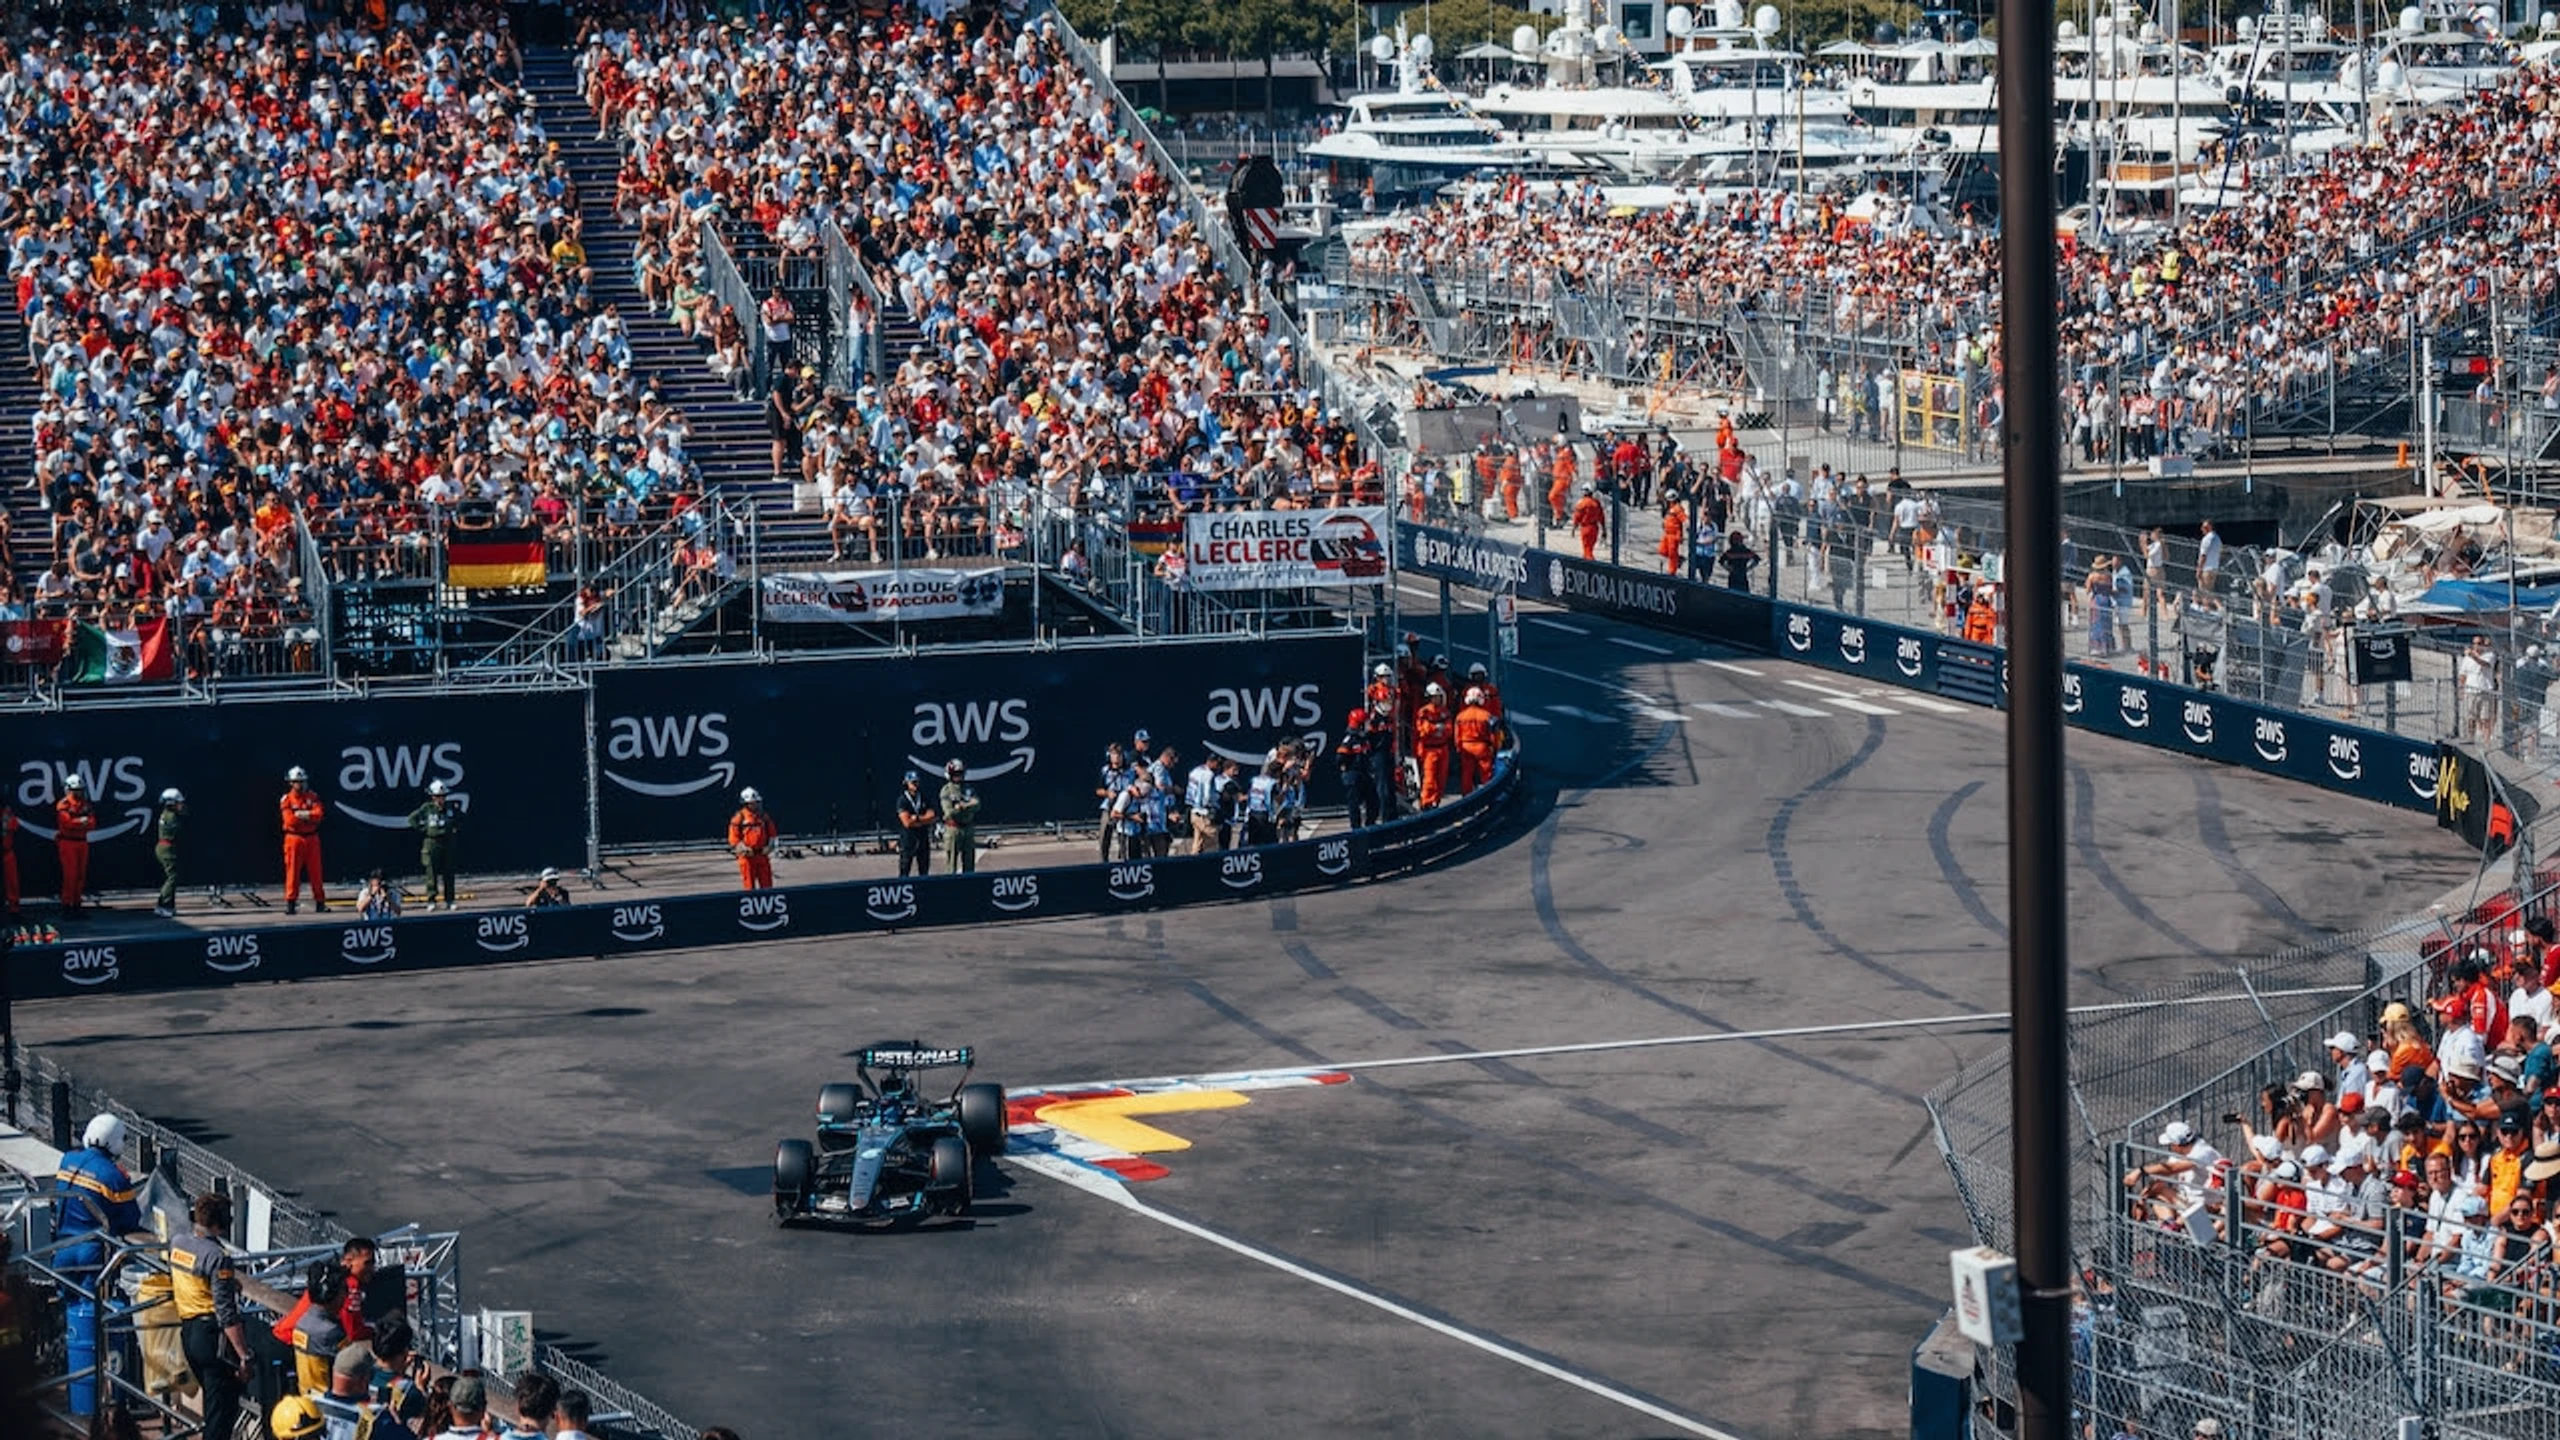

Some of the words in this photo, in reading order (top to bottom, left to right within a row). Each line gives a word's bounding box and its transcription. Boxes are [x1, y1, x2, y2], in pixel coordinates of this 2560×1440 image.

[1210, 518, 1310, 540] CHARLES
[1193, 539, 1309, 565] LECLERC
[774, 581, 829, 592] CHARLES
[872, 582, 909, 594] HAI
[1565, 568, 1617, 603] EXPLORA
[1617, 579, 1677, 615] JOURNEYS
[765, 591, 827, 606] LECLERC
[1788, 613, 1811, 636] aws
[1841, 625, 1864, 648] aws
[1897, 637, 1921, 661] aws
[1207, 684, 1322, 731] aws
[2121, 686, 2148, 711] aws
[912, 698, 1030, 746] aws
[2184, 701, 2212, 727] aws
[608, 713, 729, 760] aws
[2255, 717, 2285, 745] aws
[2329, 735, 2360, 763] aws
[339, 743, 464, 789] aws
[2409, 752, 2438, 780] aws
[18, 756, 146, 806] aws
[1318, 839, 1349, 861] aws
[1110, 865, 1153, 886] aws
[1222, 853, 1261, 875] aws
[867, 884, 915, 907] aws
[993, 875, 1038, 897] aws
[613, 905, 662, 927] aws
[740, 895, 787, 917] aws
[478, 915, 527, 937] aws
[207, 934, 259, 957] aws
[342, 927, 394, 949] aws
[64, 947, 117, 971] aws
[874, 1050, 960, 1065] PETRONAS
